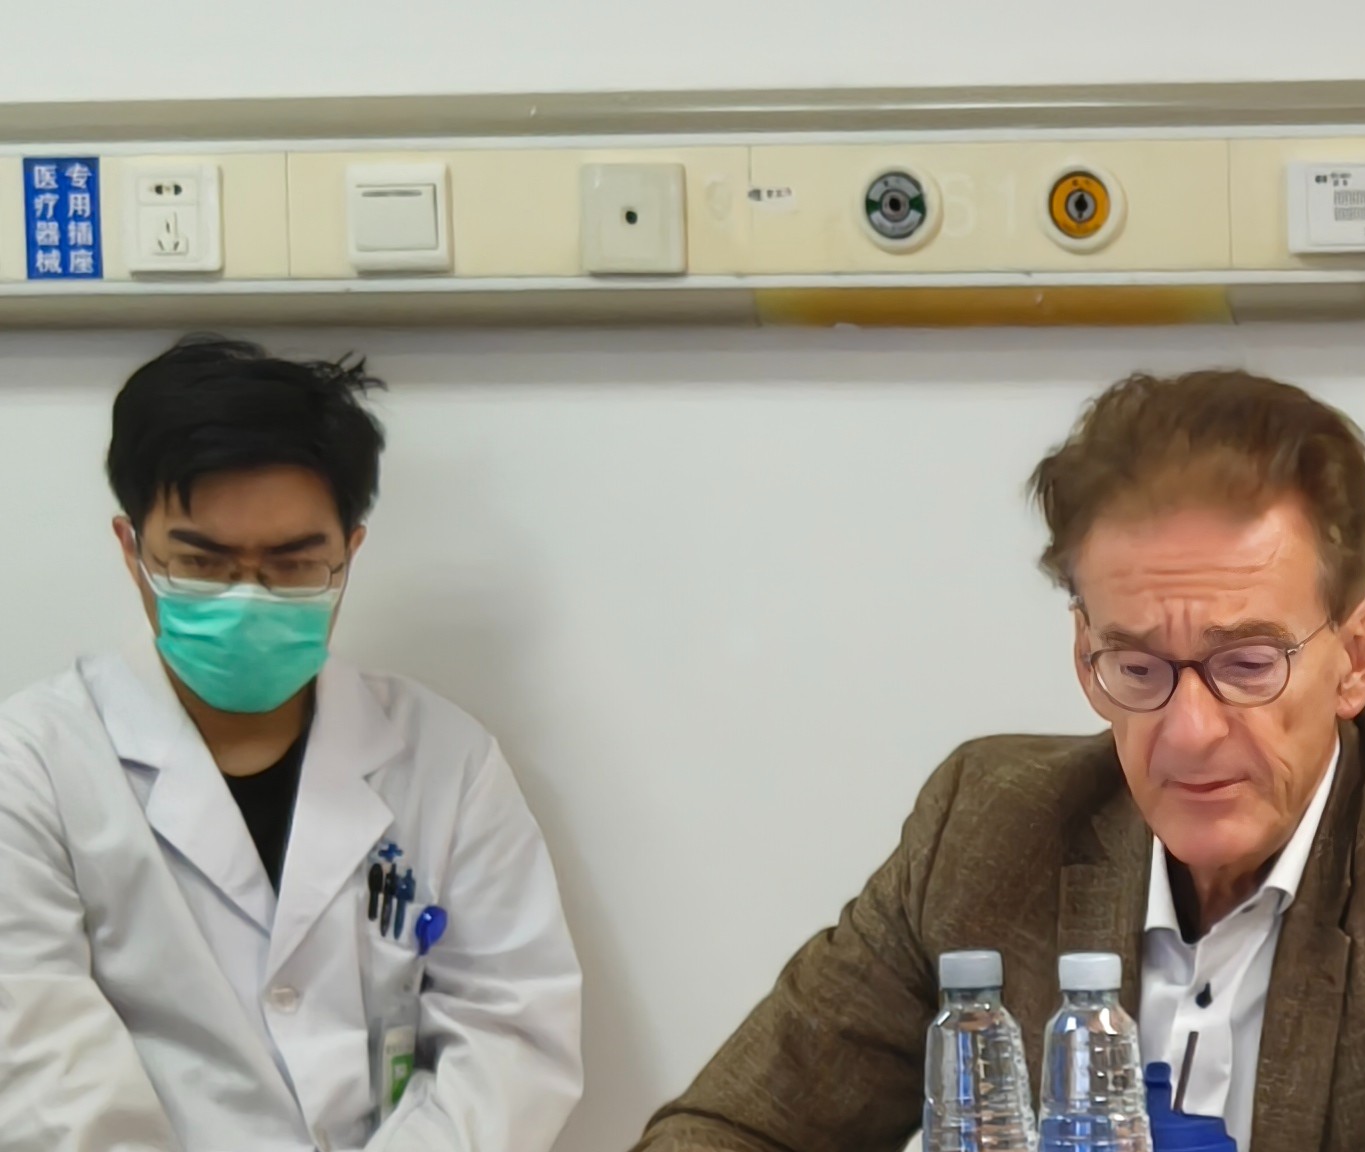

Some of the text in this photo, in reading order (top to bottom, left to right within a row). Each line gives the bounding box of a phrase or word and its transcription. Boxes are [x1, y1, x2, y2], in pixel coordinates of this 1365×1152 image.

[33, 163, 63, 274] 医疗器械
[64, 162, 95, 274] 专用插座
